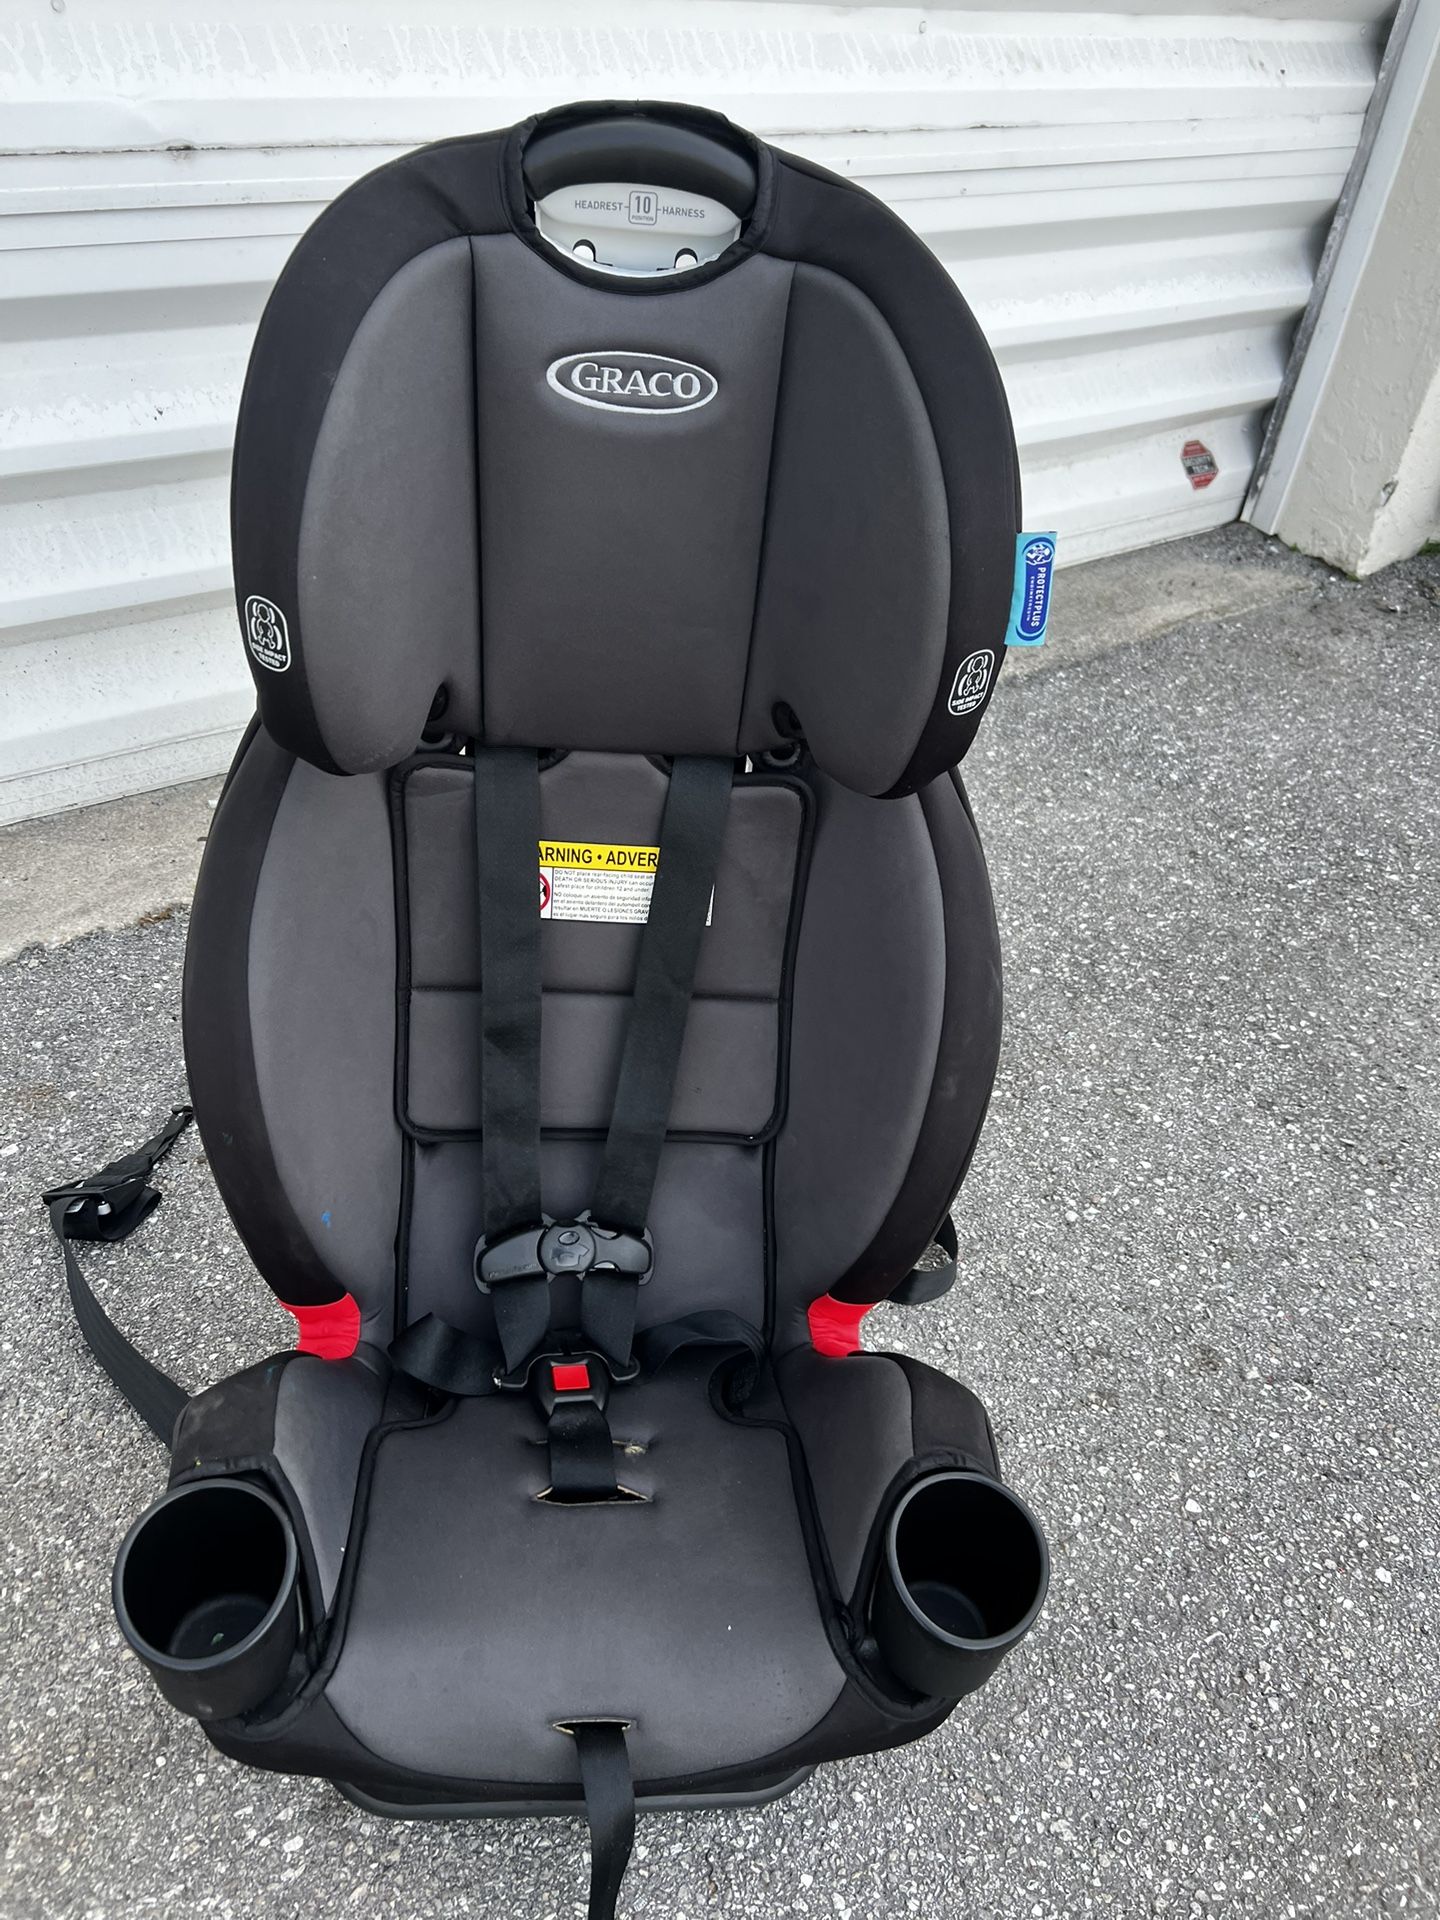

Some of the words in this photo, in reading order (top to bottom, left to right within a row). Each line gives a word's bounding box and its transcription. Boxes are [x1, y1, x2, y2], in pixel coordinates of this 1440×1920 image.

[574, 200, 624, 212] HEADREST
[634, 196, 651, 214] 10
[662, 206, 705, 218] HARNESS
[571, 362, 701, 399] GRACO
[1030, 566, 1046, 627] PROTECTPLUS
[952, 698, 965, 706] SIDE
[965, 692, 984, 702] IMPACT
[957, 700, 976, 711] TESTED
